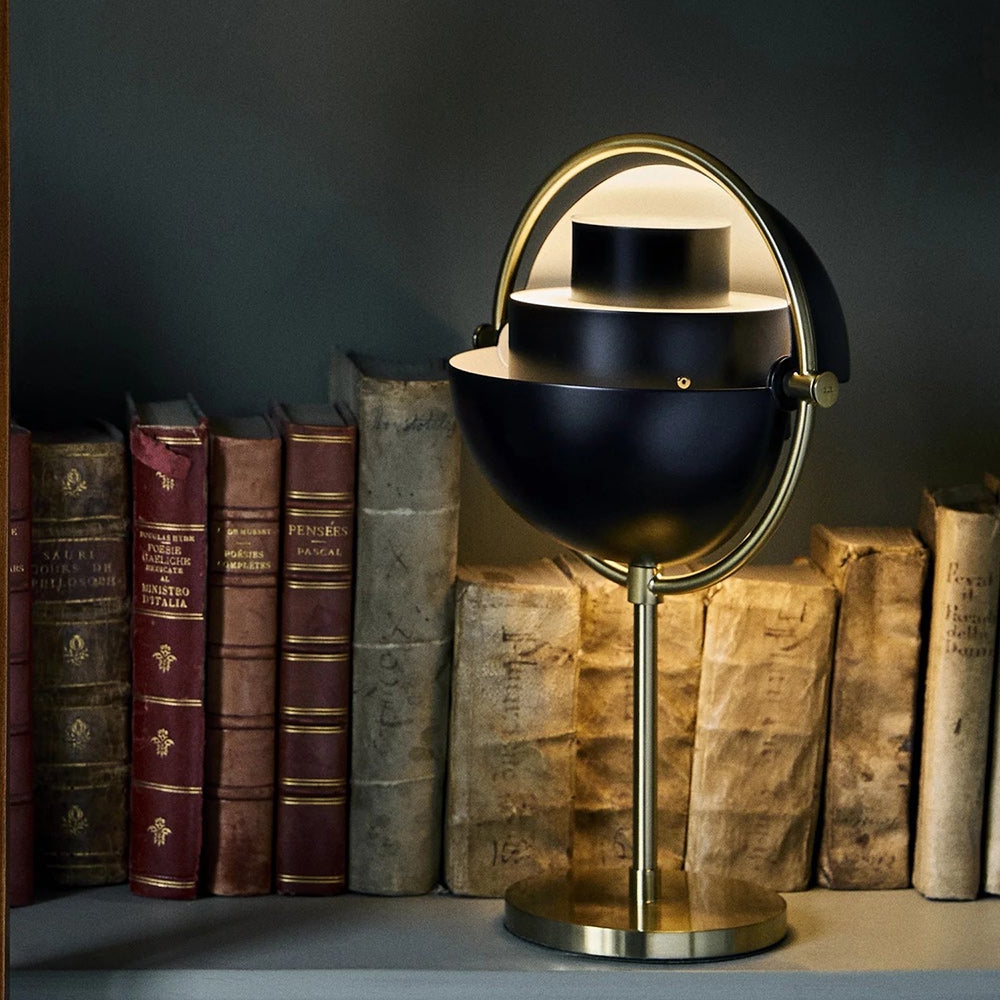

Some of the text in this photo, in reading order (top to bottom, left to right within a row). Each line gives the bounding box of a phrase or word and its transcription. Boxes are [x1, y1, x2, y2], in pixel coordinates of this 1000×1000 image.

[288, 521, 350, 538] PENSÉES
[147, 543, 182, 555] POESIE
[297, 547, 344, 558] PASCAL
[160, 575, 170, 583] AL
[141, 583, 191, 598] MINISTRO
